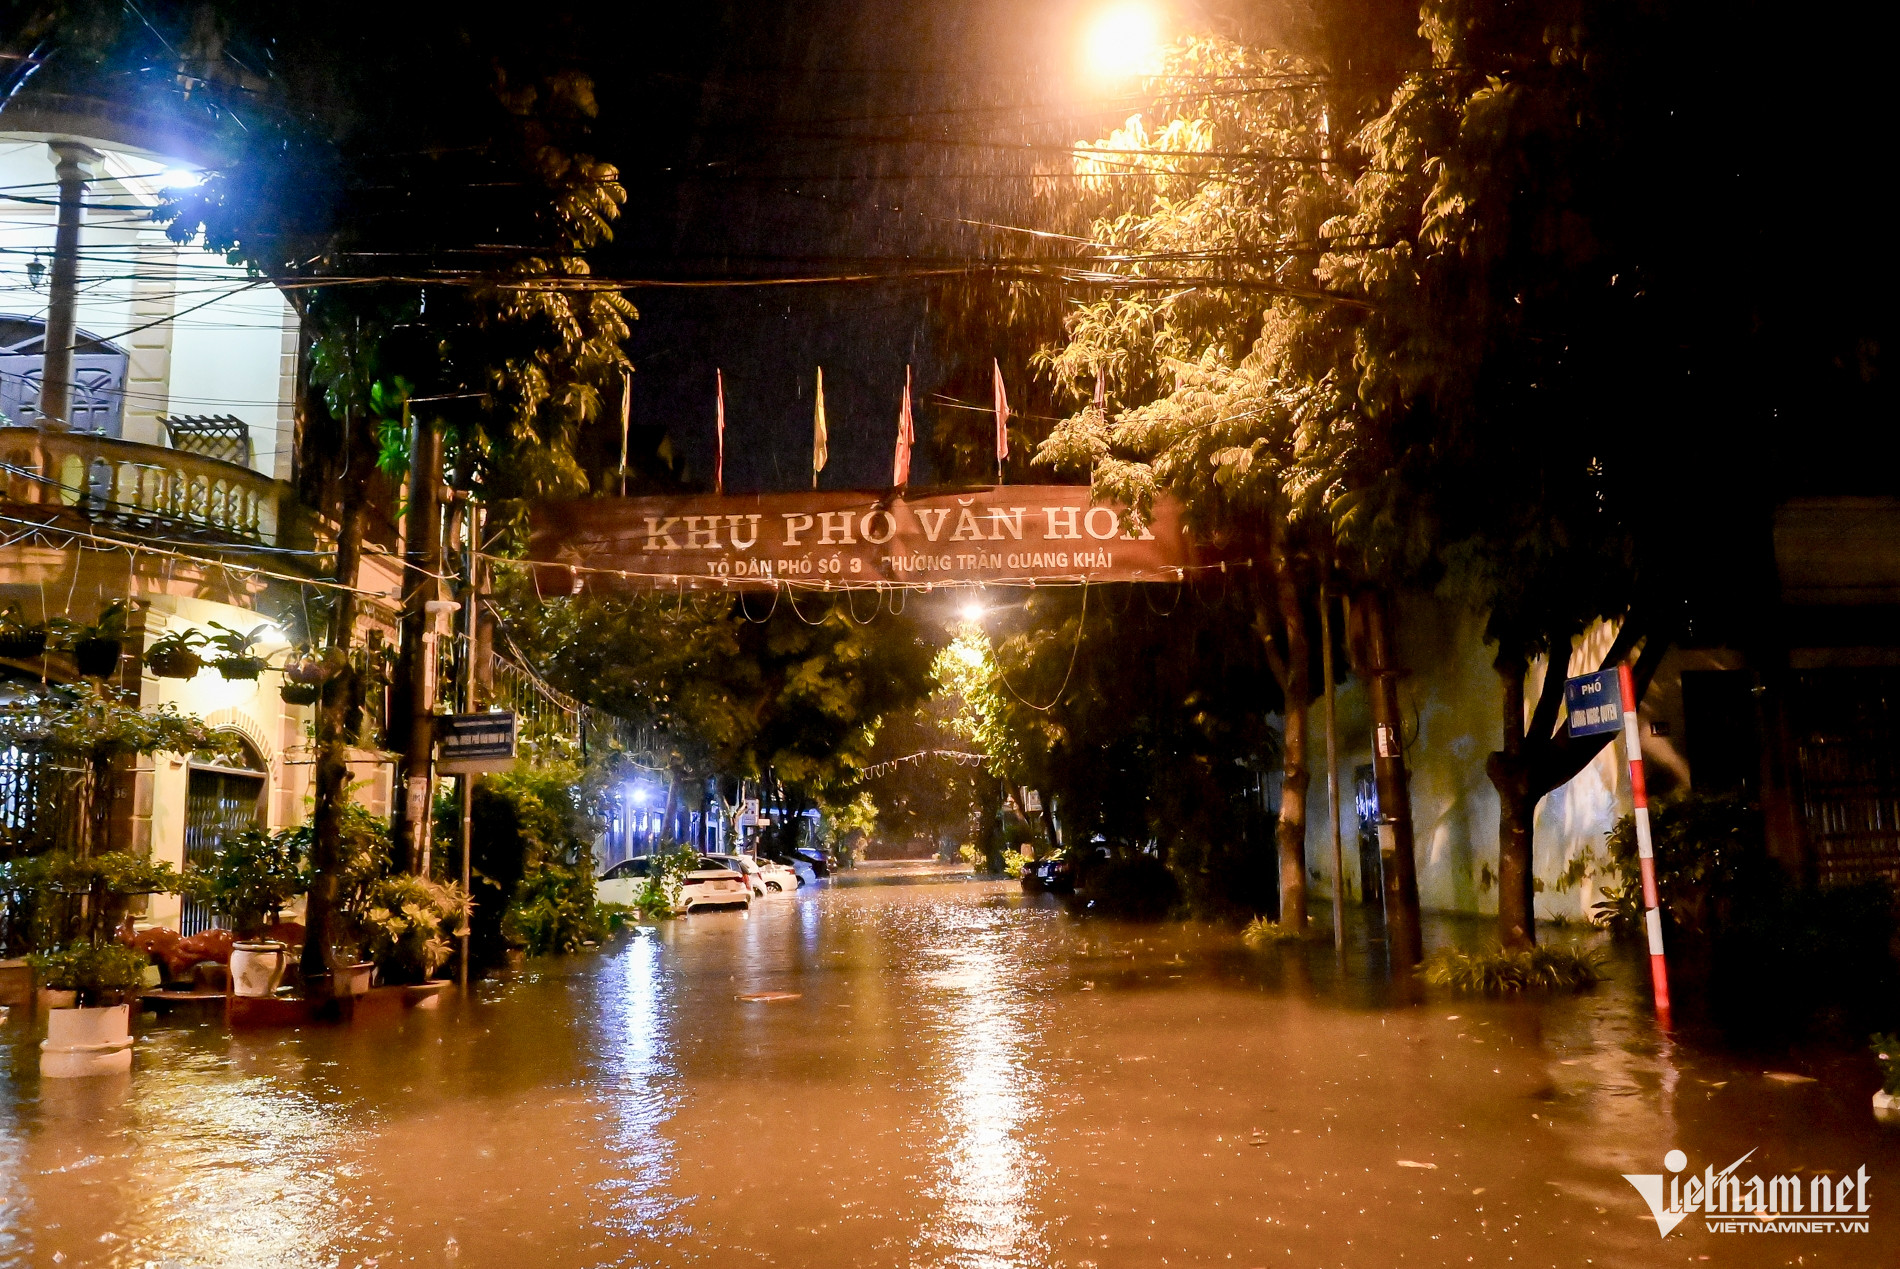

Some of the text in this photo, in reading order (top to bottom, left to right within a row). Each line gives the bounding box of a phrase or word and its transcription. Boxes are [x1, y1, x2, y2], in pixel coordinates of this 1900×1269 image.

[643, 514, 762, 550] KHU
[782, 500, 896, 546] PHỐ
[914, 498, 1026, 541] VĂN
[778, 552, 813, 574] PHỐ
[818, 551, 841, 574] SỐ
[850, 558, 861, 573] 3
[957, 546, 1001, 570] TRẦN
[1007, 552, 1068, 569] QUANG
[1073, 547, 1112, 568] KHẢI
